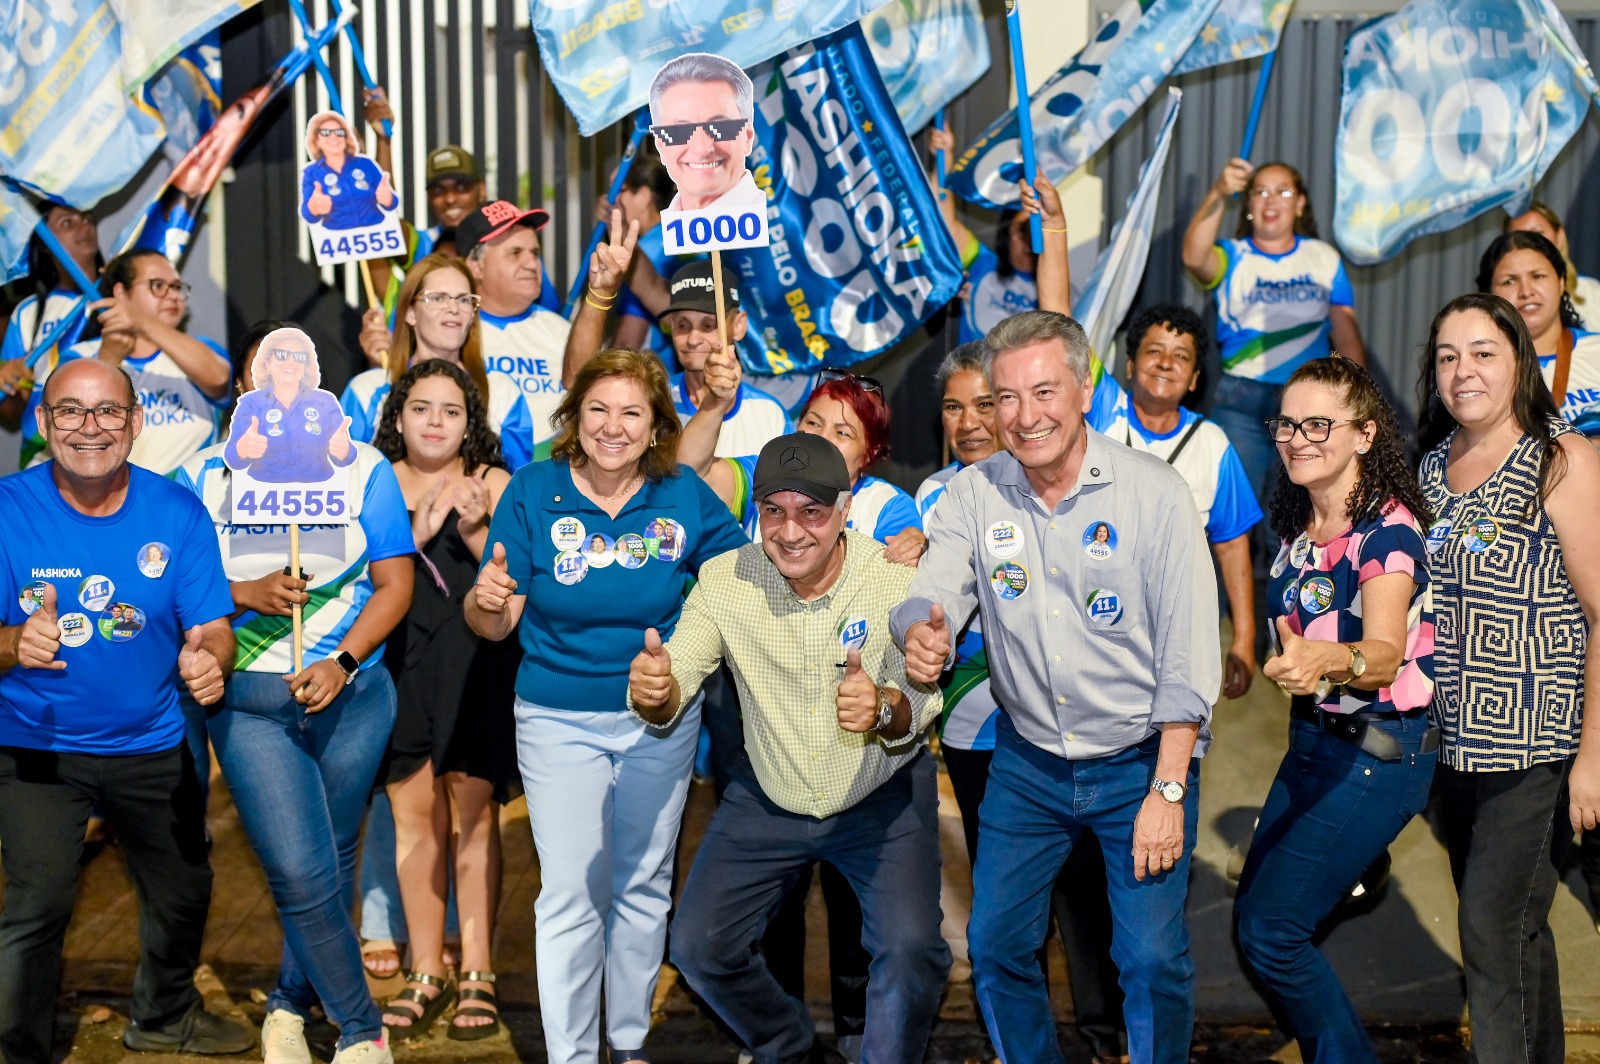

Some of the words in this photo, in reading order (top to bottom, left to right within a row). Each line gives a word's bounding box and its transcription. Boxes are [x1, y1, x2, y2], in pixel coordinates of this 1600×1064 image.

[869, 136, 920, 238] FEDERAL
[666, 212, 762, 248] 1000
[320, 230, 400, 258] 44555
[767, 222, 798, 287] PELO
[671, 276, 715, 295] UBATUBA
[237, 490, 346, 516] 44555
[993, 530, 1012, 539] 222
[32, 568, 82, 578] HASHIOKA
[63, 620, 82, 629] 222
